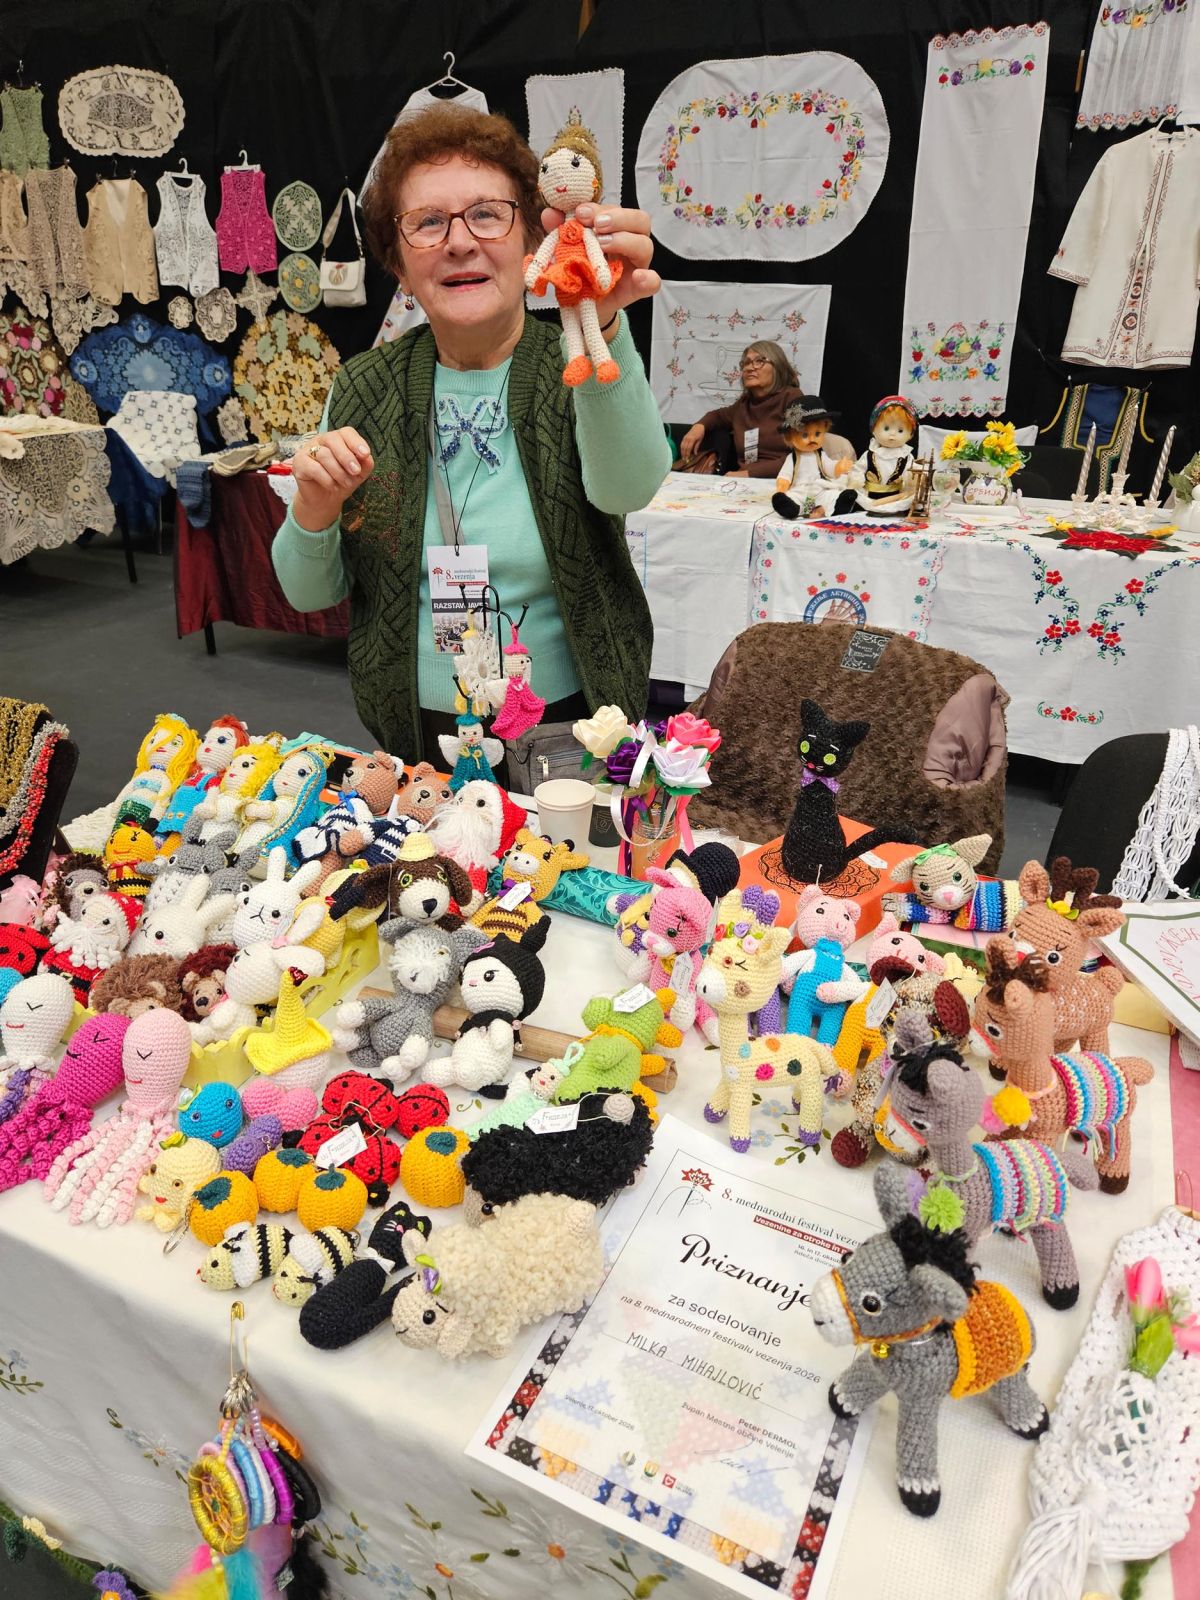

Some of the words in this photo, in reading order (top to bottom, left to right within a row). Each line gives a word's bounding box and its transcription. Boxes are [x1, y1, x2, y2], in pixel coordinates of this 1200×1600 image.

[721, 1187, 733, 1201] 8.
[735, 1196, 797, 1224] mednarodni
[797, 1215, 834, 1238] festival
[755, 1216, 792, 1234] Vezenine
[791, 1229, 802, 1239] za
[802, 1234, 831, 1250] otroke
[831, 1243, 841, 1253] in
[680, 1233, 812, 1312] Priznanje
[620, 1295, 633, 1304] na
[644, 1305, 711, 1336] mednarodnem
[712, 1331, 754, 1355] festivalu
[755, 1351, 793, 1373] vezenja
[793, 1367, 822, 1384] 2026
[668, 1294, 686, 1308] za
[688, 1301, 782, 1347] sodelovanje
[626, 1331, 668, 1358] MILKA
[681, 1354, 765, 1400] MIHAJLOVIĆ
[706, 1413, 736, 1432] Mestne
[765, 1441, 795, 1459] Velenje
[738, 1418, 761, 1433] Peter
[762, 1428, 798, 1450] DERMOL
